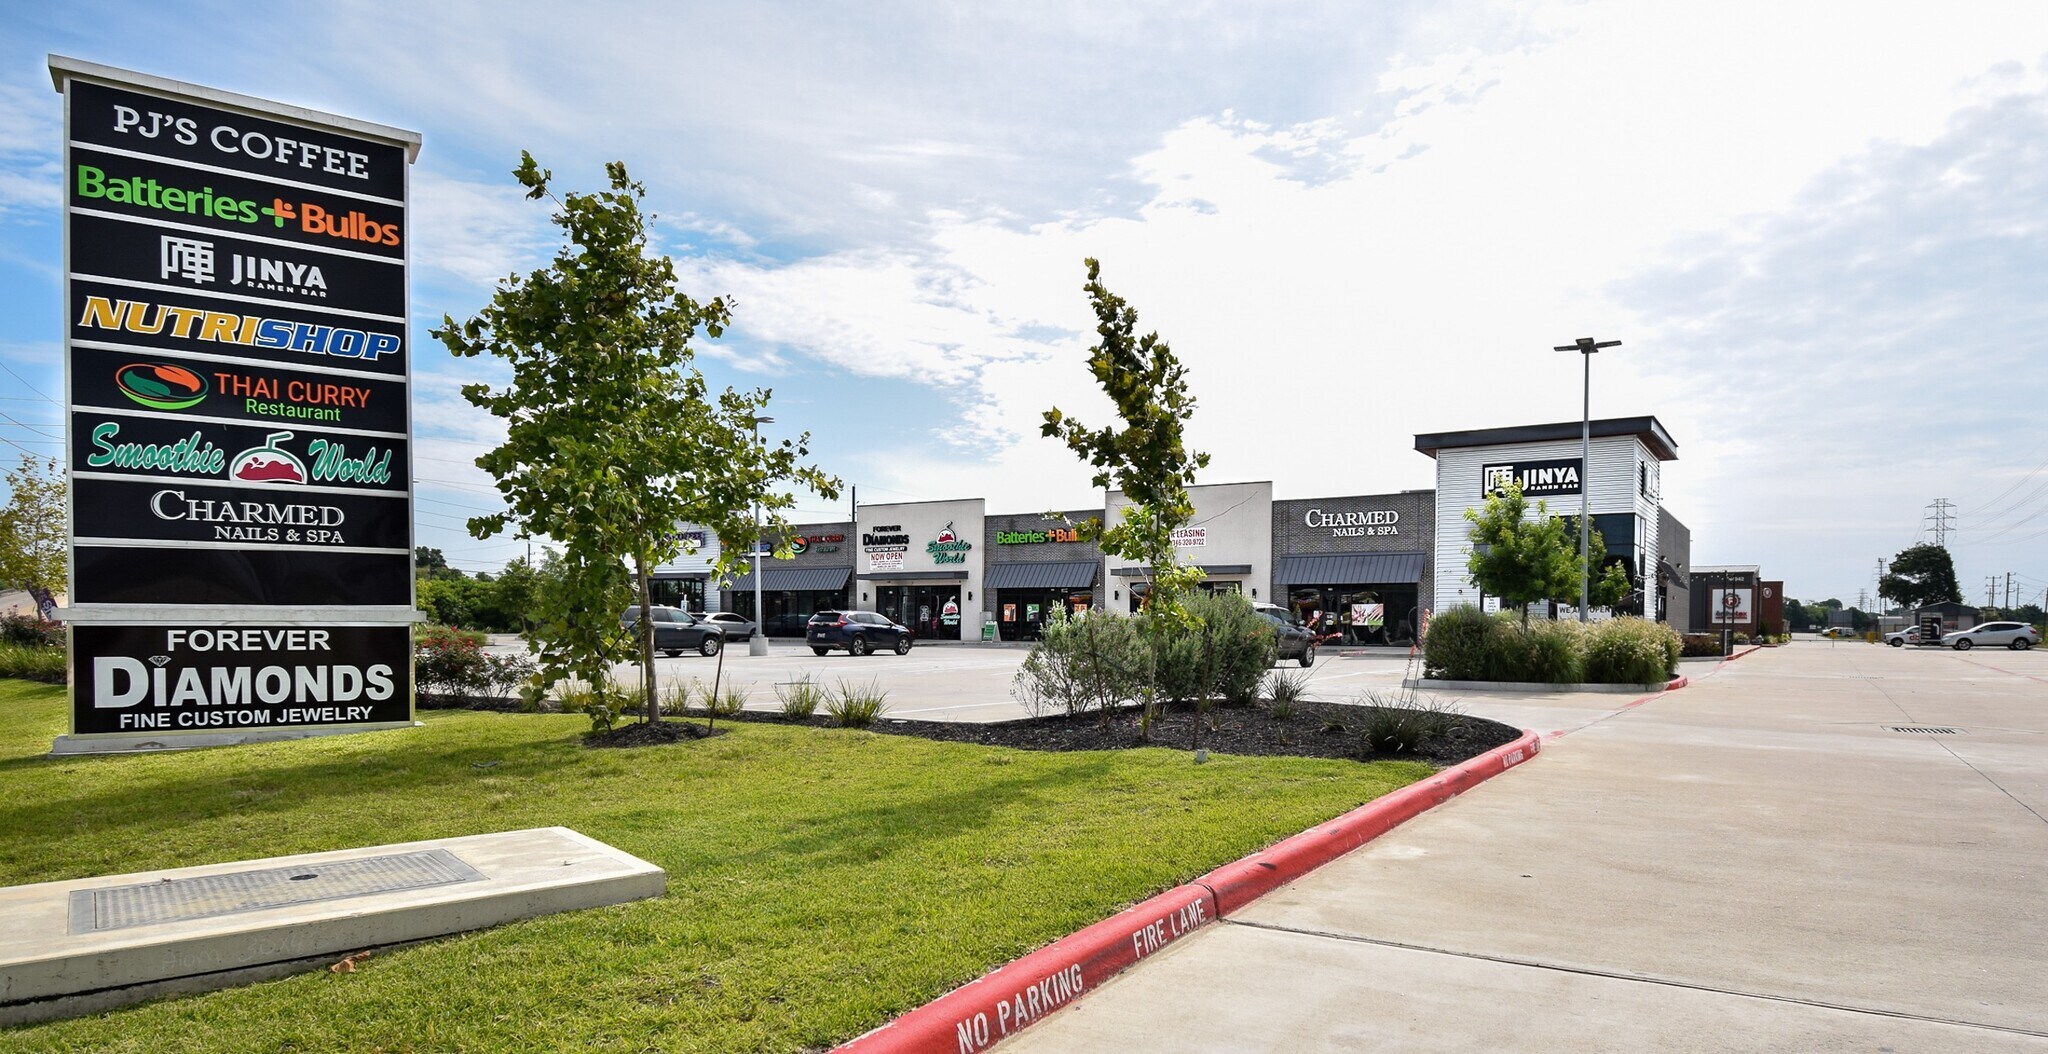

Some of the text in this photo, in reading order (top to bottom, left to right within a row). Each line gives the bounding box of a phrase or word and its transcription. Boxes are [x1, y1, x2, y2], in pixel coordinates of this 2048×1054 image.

[113, 105, 369, 180] PJ'S COFFEE
[77, 163, 259, 224] Batteries
[301, 202, 400, 247] Bulbs
[230, 253, 328, 290] JINYA
[247, 281, 327, 298] RAMEN BAR
[78, 295, 401, 361] NUTRISHOP
[214, 372, 371, 408] THAI CURRY
[246, 398, 341, 422] Restaurant
[87, 422, 392, 485] Smoothie World
[1522, 466, 1580, 491] JINYA
[150, 489, 345, 527] CHARMED
[1305, 508, 1399, 528] CHARMED
[214, 526, 345, 544] NAILS & SPA
[872, 525, 902, 533] FOREVER
[996, 530, 1045, 545] Batteries
[1176, 528, 1205, 539] LEASING
[1332, 526, 1399, 537] NAILS & SPA
[871, 552, 903, 561] NOW OPEN
[925, 540, 972, 553] Smoothie
[932, 552, 966, 564] World
[166, 629, 331, 652] FOREVER
[119, 705, 374, 728] FINE CUSTOM JEWELRY
[1131, 897, 1207, 959] FIRE LANE
[956, 963, 1084, 1054] NO PARKING
